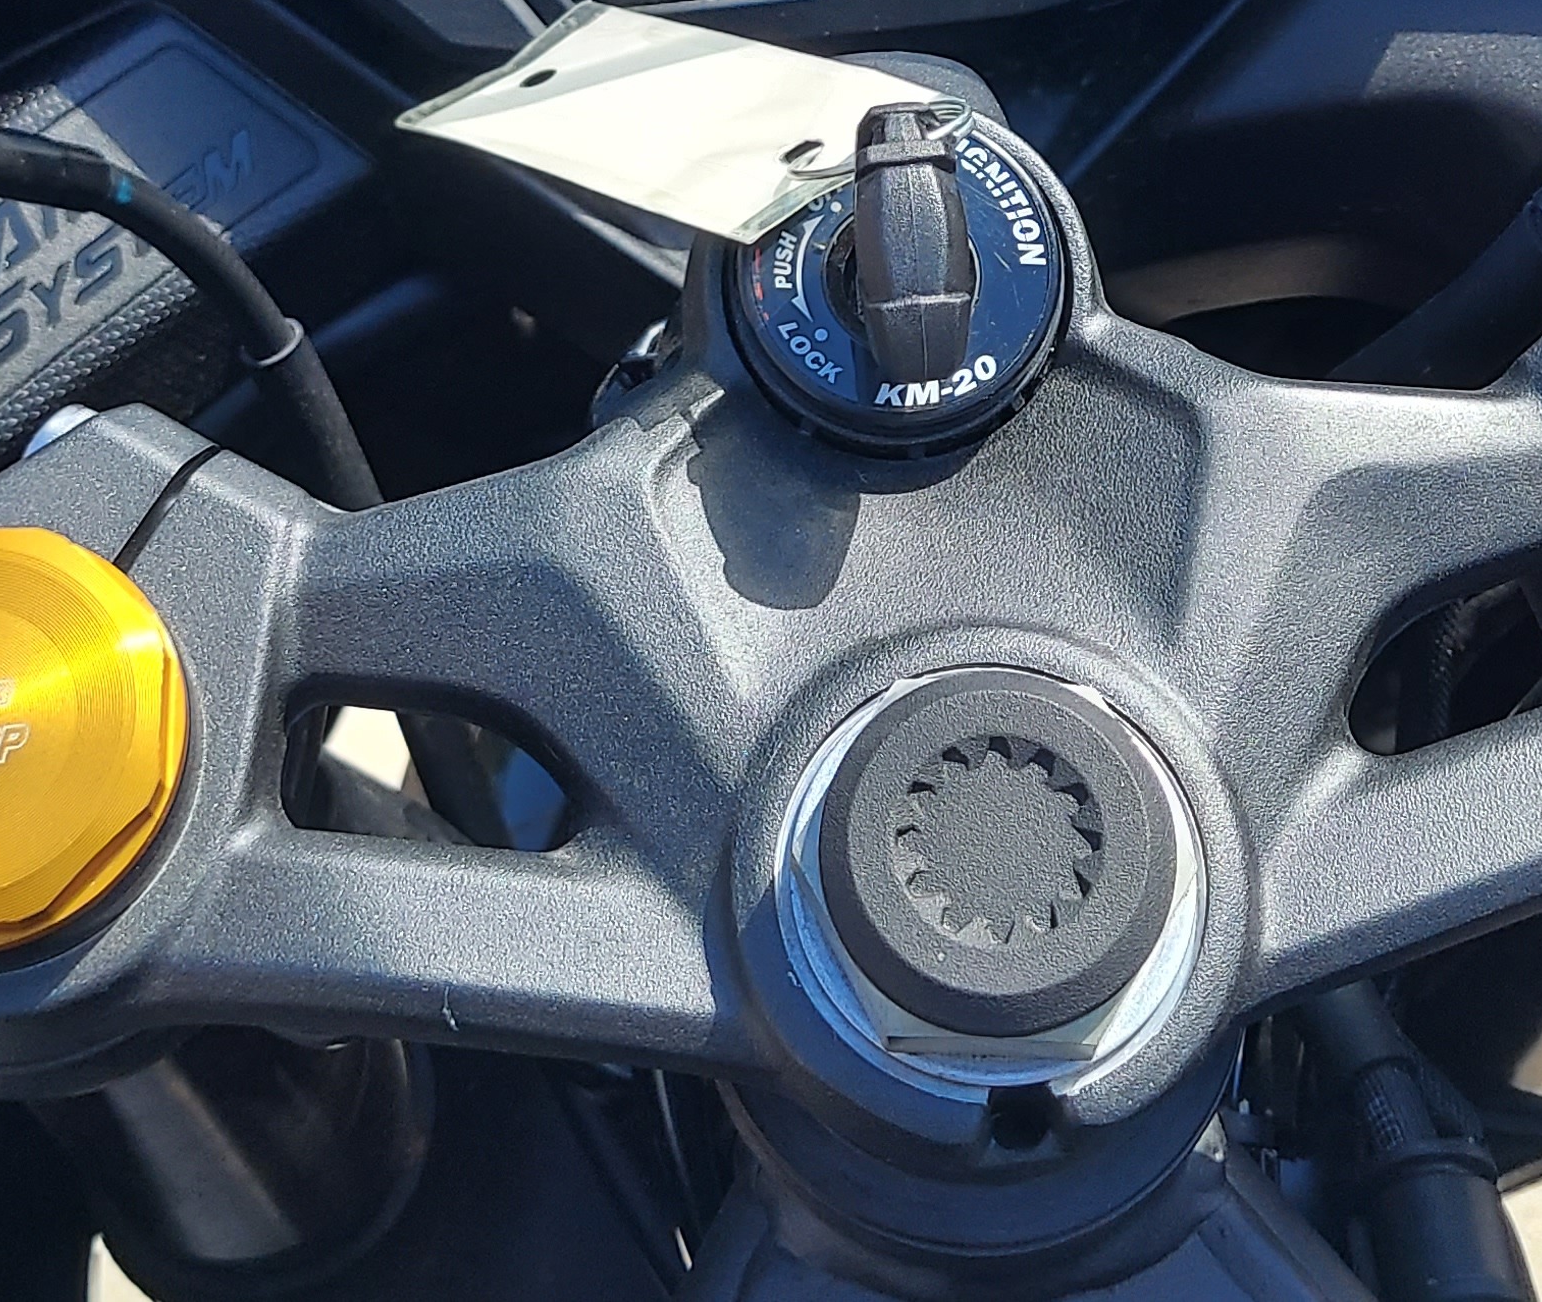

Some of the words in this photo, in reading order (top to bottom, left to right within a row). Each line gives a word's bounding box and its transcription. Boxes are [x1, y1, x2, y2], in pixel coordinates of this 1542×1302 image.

[955, 138, 1049, 267] IGNITION
[772, 229, 799, 290] PUSH
[777, 320, 845, 386] LOCK
[873, 353, 999, 408] KM-20
